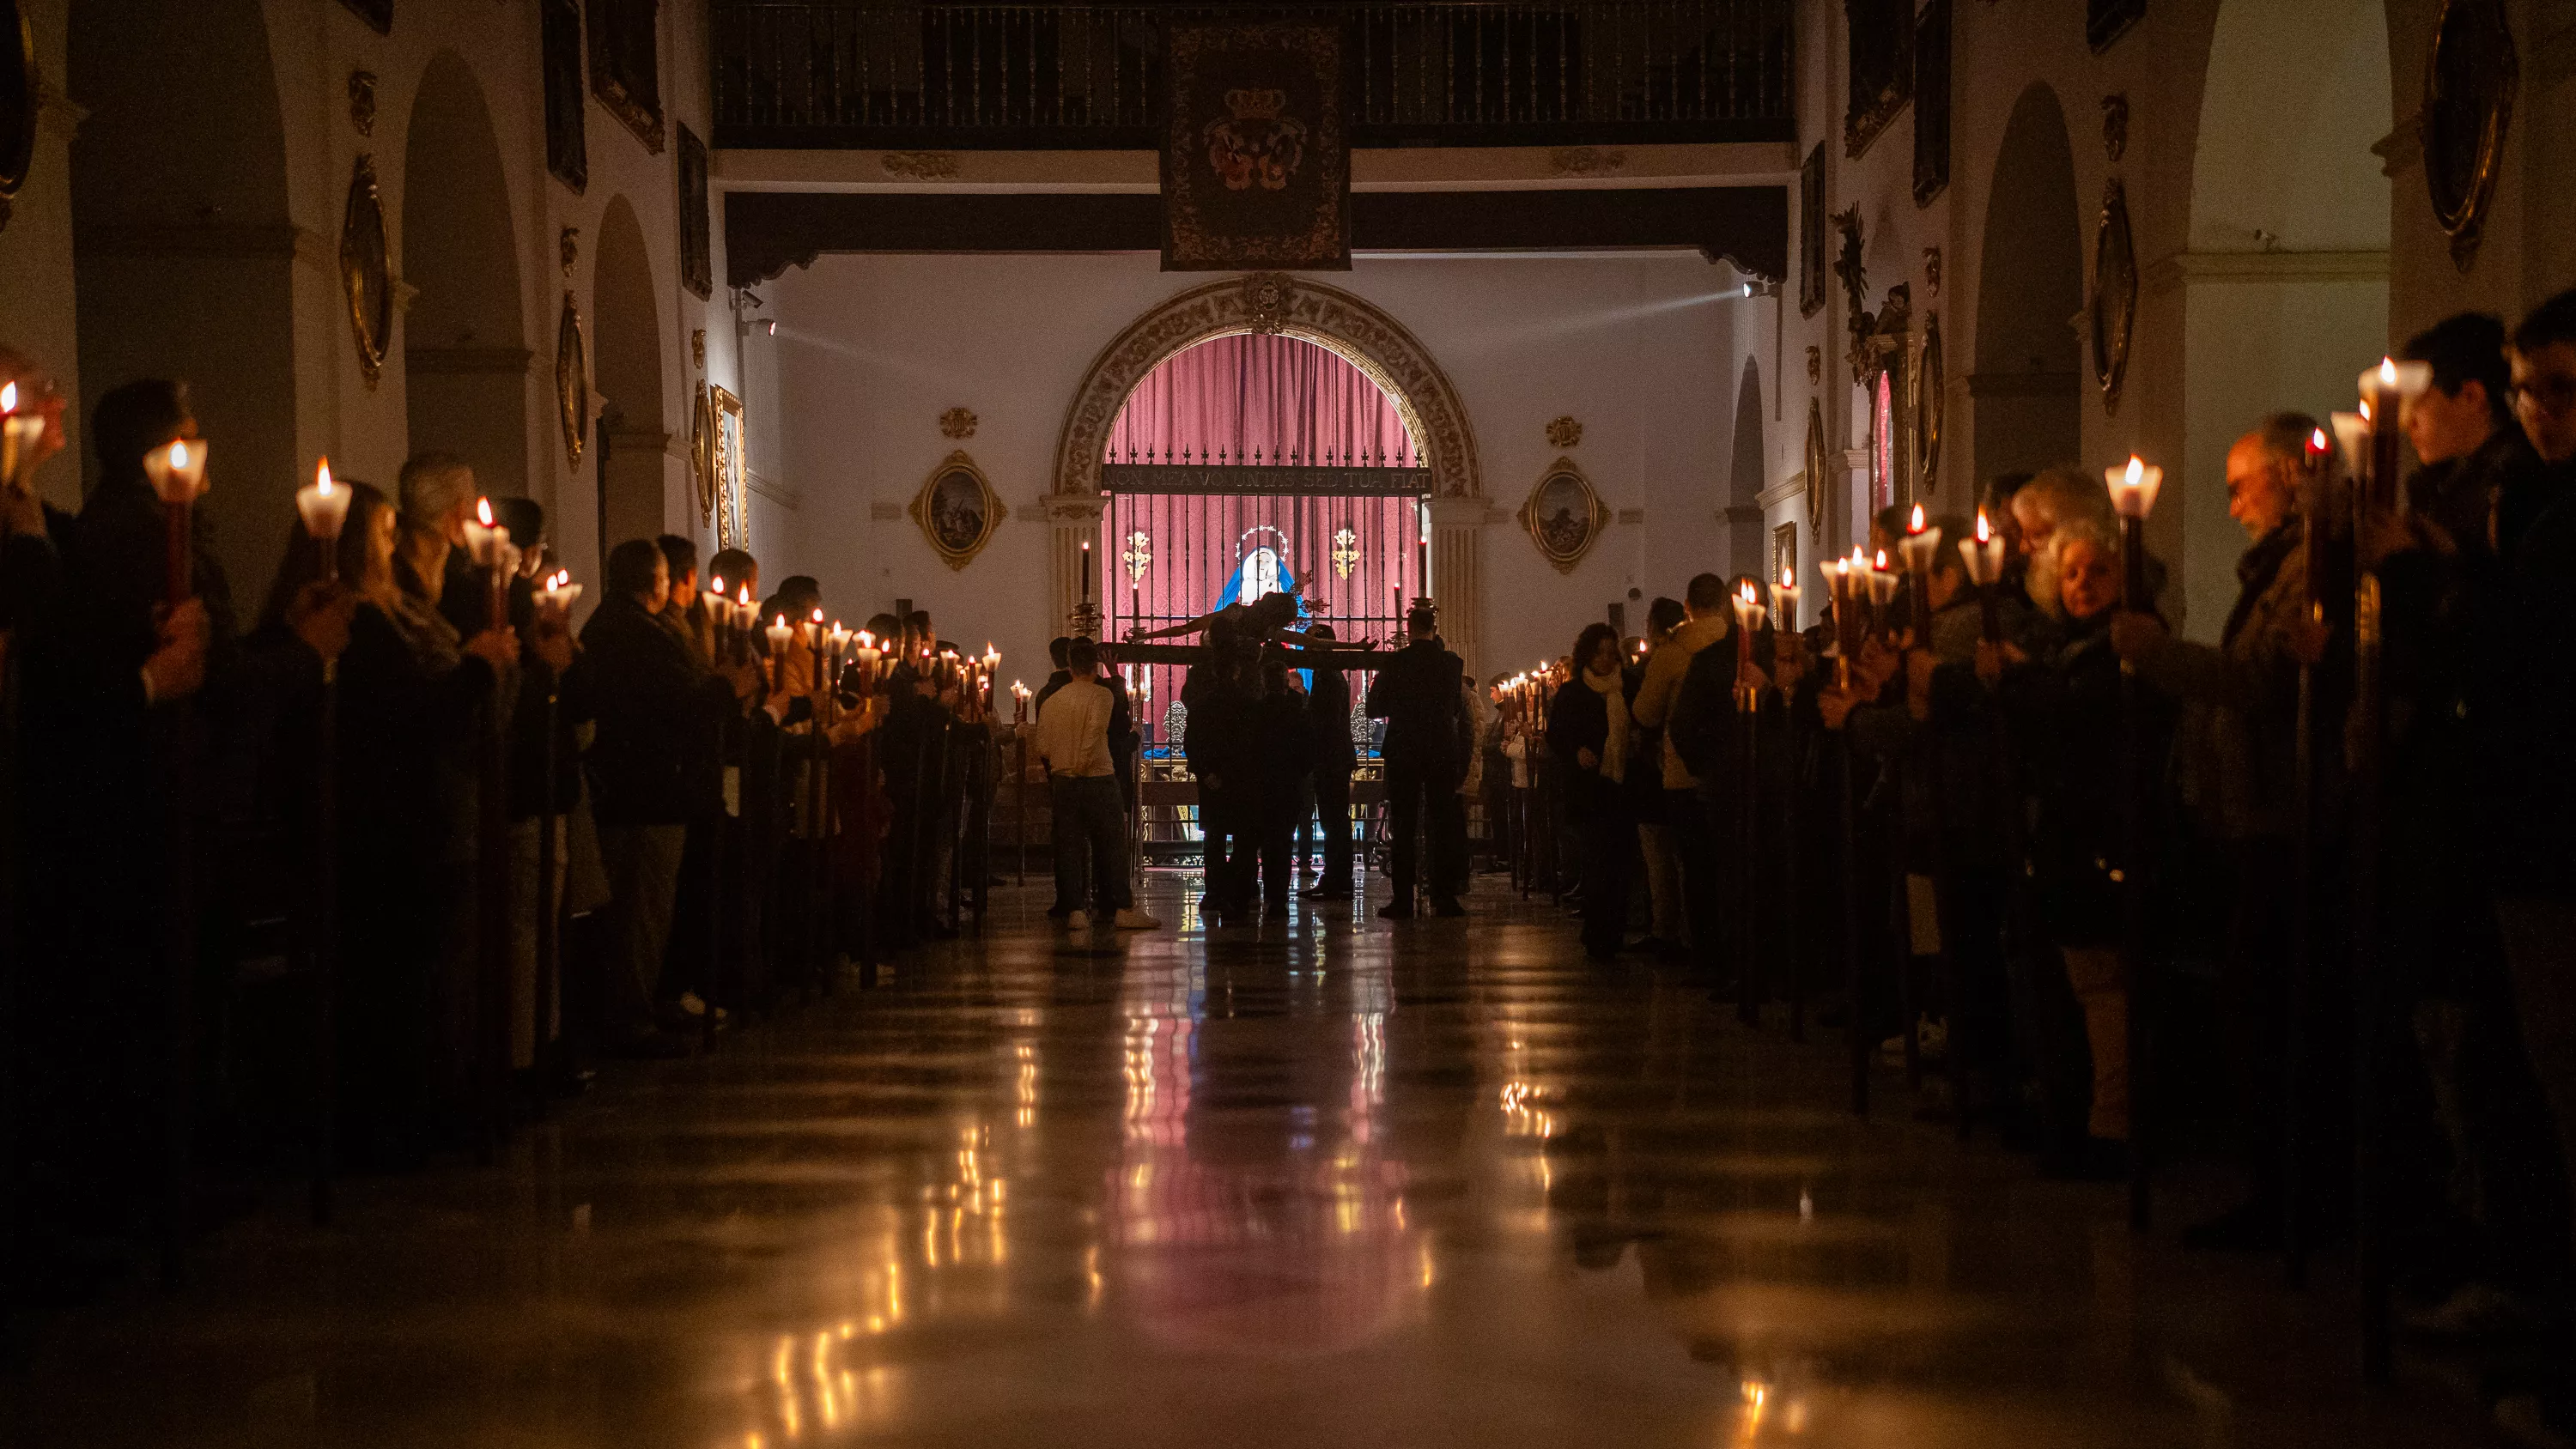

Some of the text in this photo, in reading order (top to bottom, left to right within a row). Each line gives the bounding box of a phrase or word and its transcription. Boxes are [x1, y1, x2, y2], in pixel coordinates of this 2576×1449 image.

[1104, 470, 1145, 485] NON
[1153, 470, 1192, 486] MEA
[1303, 472, 1339, 488] SED
[1344, 472, 1384, 488] TUA
[1390, 473, 1431, 488] FIAT
